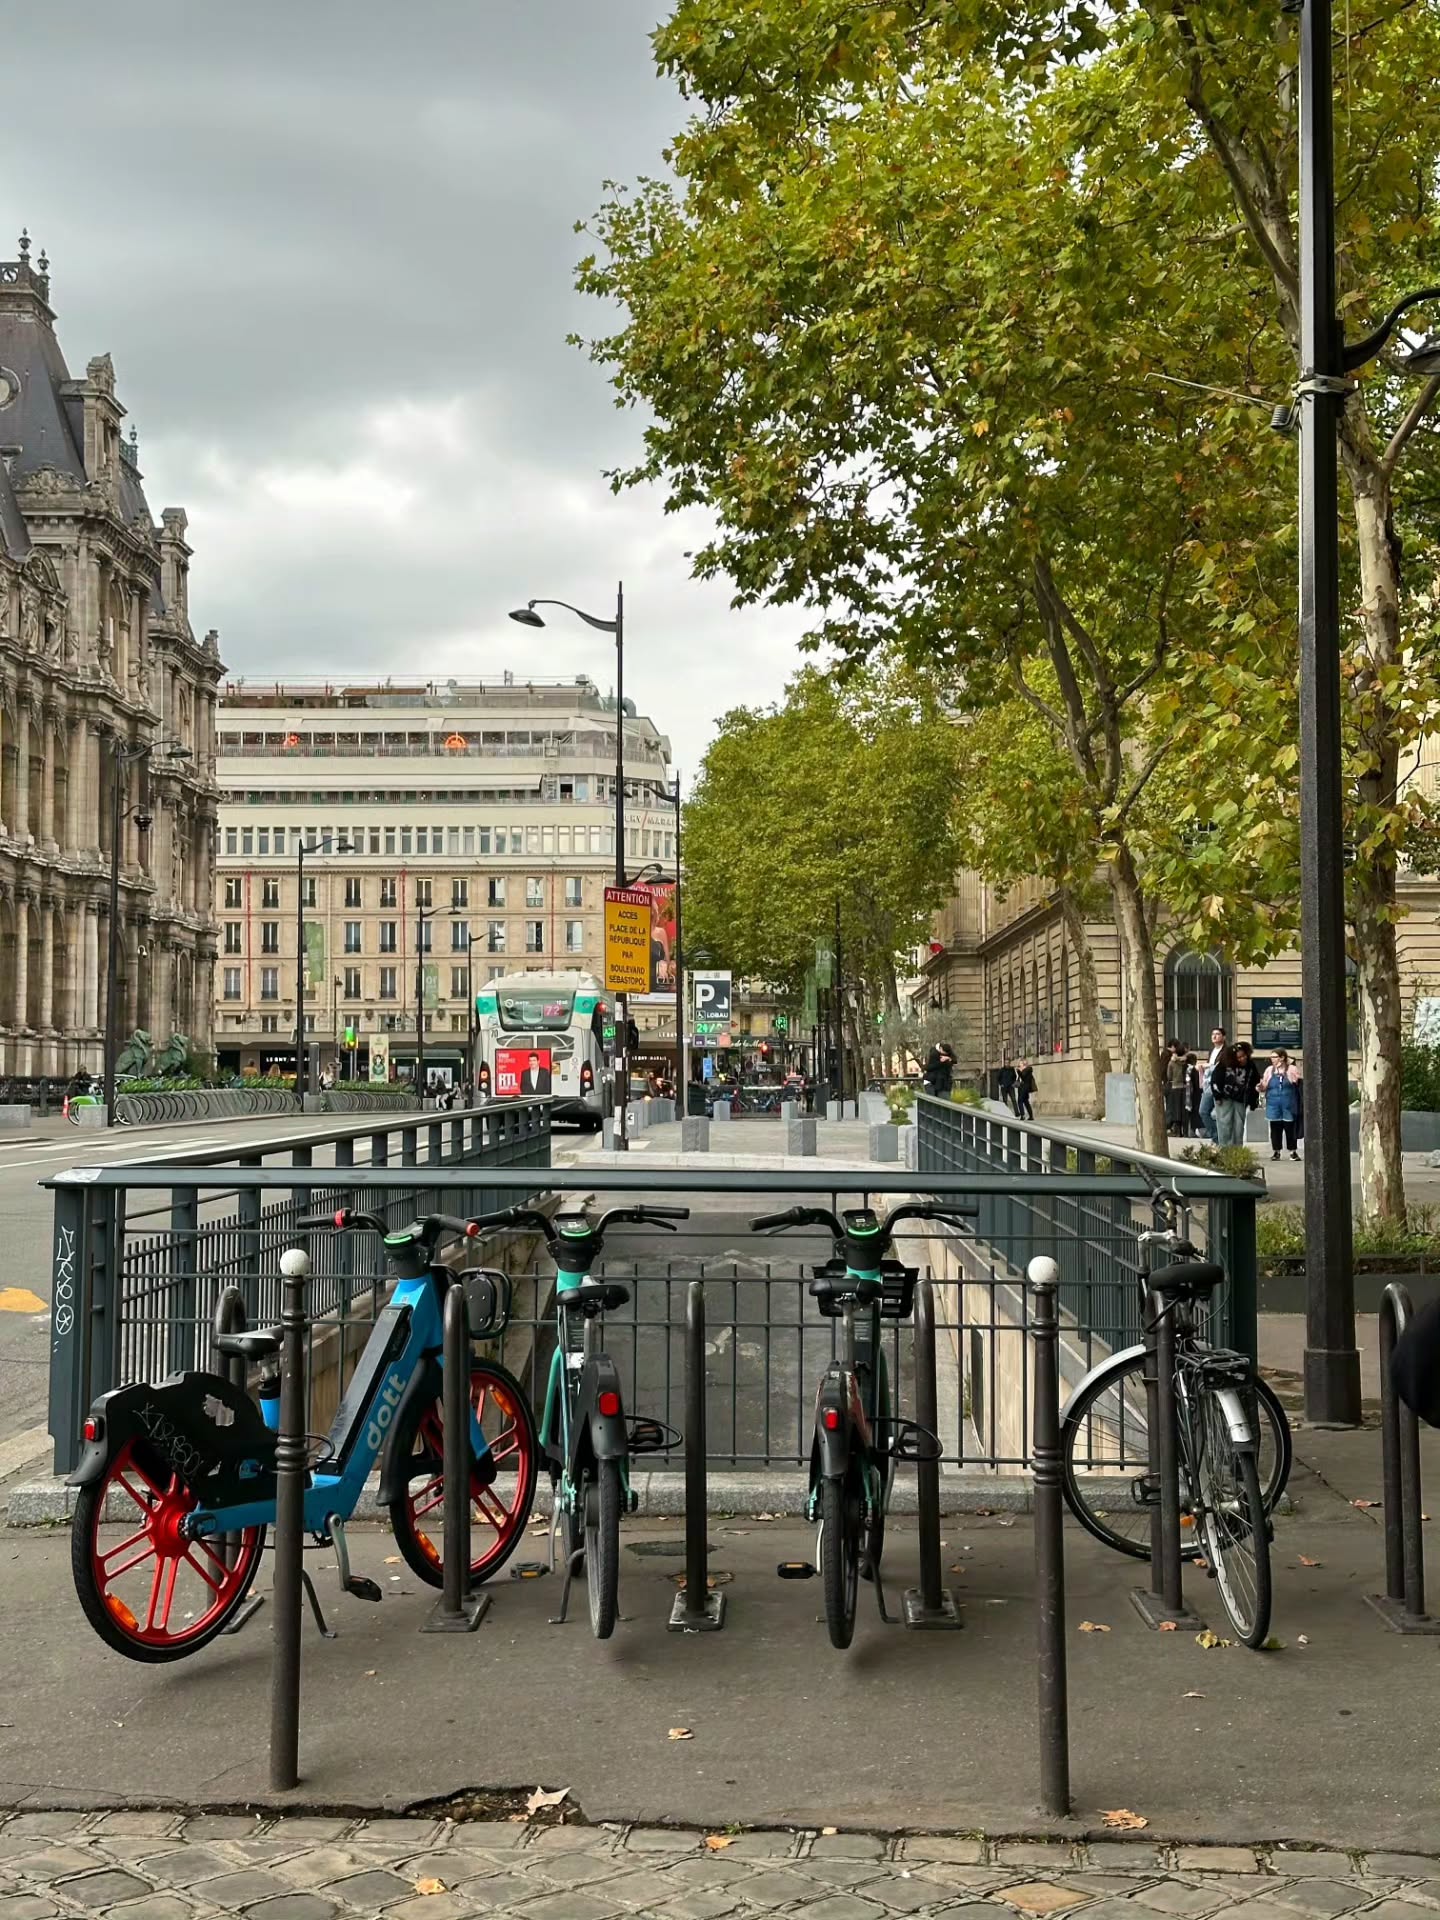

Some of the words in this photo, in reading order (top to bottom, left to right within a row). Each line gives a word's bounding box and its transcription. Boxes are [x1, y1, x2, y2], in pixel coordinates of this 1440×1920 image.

[606, 890, 650, 904] ATTENTION
[609, 924, 629, 934] PLACE
[630, 926, 638, 934] DE
[638, 927, 646, 935] LA
[621, 950, 634, 959] PAR
[610, 963, 646, 975] BOULEVARD
[696, 983, 716, 1009] P
[545, 1005, 560, 1016] 72
[498, 1072, 517, 1088] RTL
[367, 1373, 406, 1450] dott
